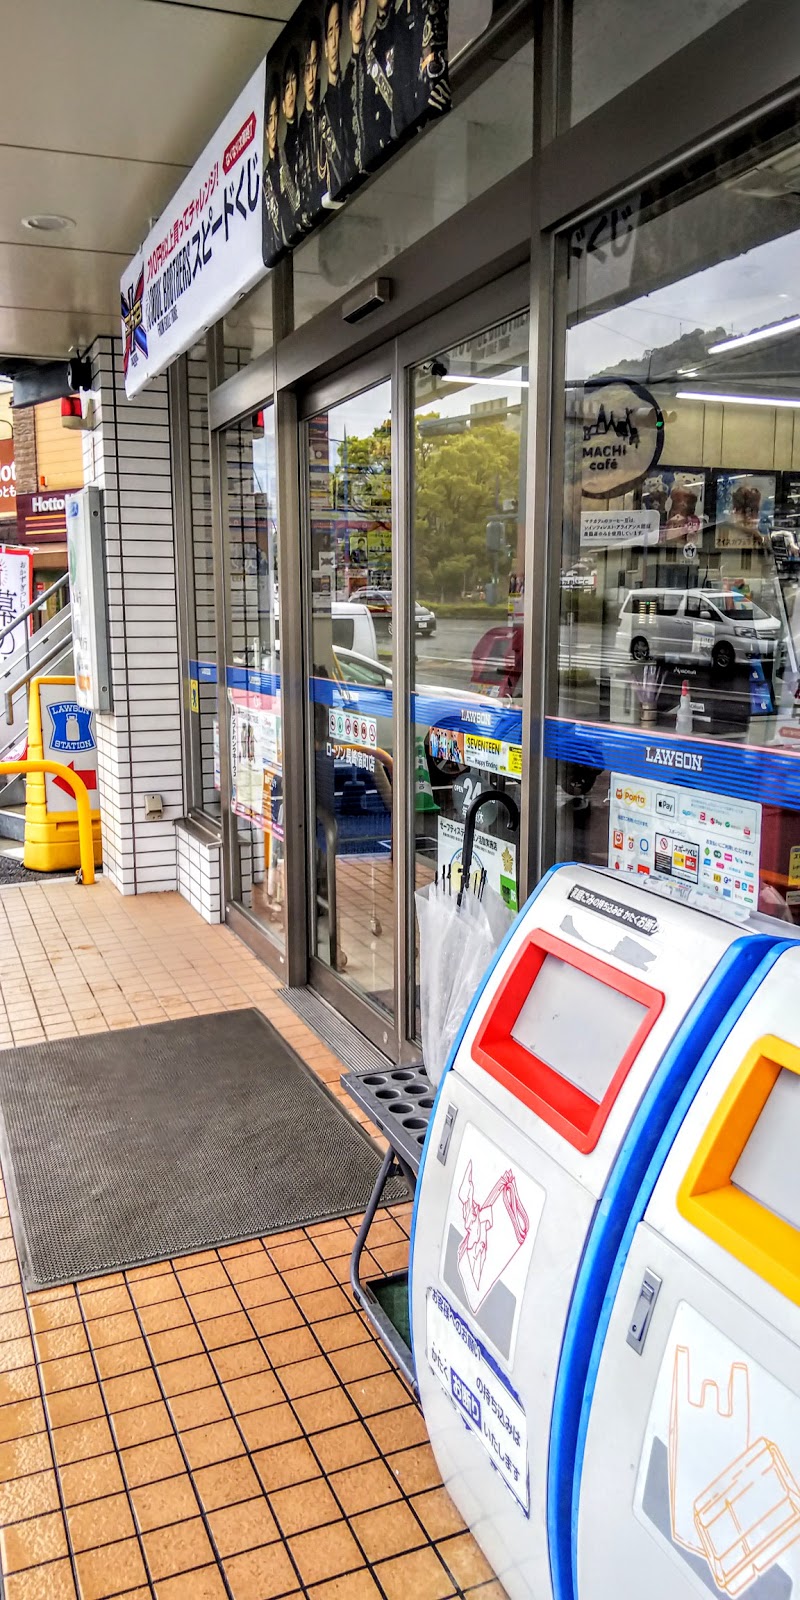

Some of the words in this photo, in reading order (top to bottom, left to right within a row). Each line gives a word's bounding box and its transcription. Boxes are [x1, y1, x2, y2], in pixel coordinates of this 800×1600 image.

[192, 152, 260, 279] スピードくじ
[582, 444, 627, 458] MACHI
[589, 458, 617, 470] café
[32, 496, 65, 513] Hotto
[51, 704, 89, 715] LAWSON
[461, 709, 491, 725] LAWSON
[54, 740, 92, 749] STATION
[467, 737, 500, 755] SEVENTEEN
[645, 747, 703, 771] LAWSON
[454, 784, 464, 794] OPEN
[624, 791, 645, 804] Ponta
[663, 800, 673, 812] Pay
[432, 1288, 482, 1361] お客様へのお願い
[431, 1346, 449, 1382] かたく
[452, 1373, 481, 1420] お断り
[483, 1422, 521, 1482] いたします
[476, 1377, 521, 1448] の持ち込みは
